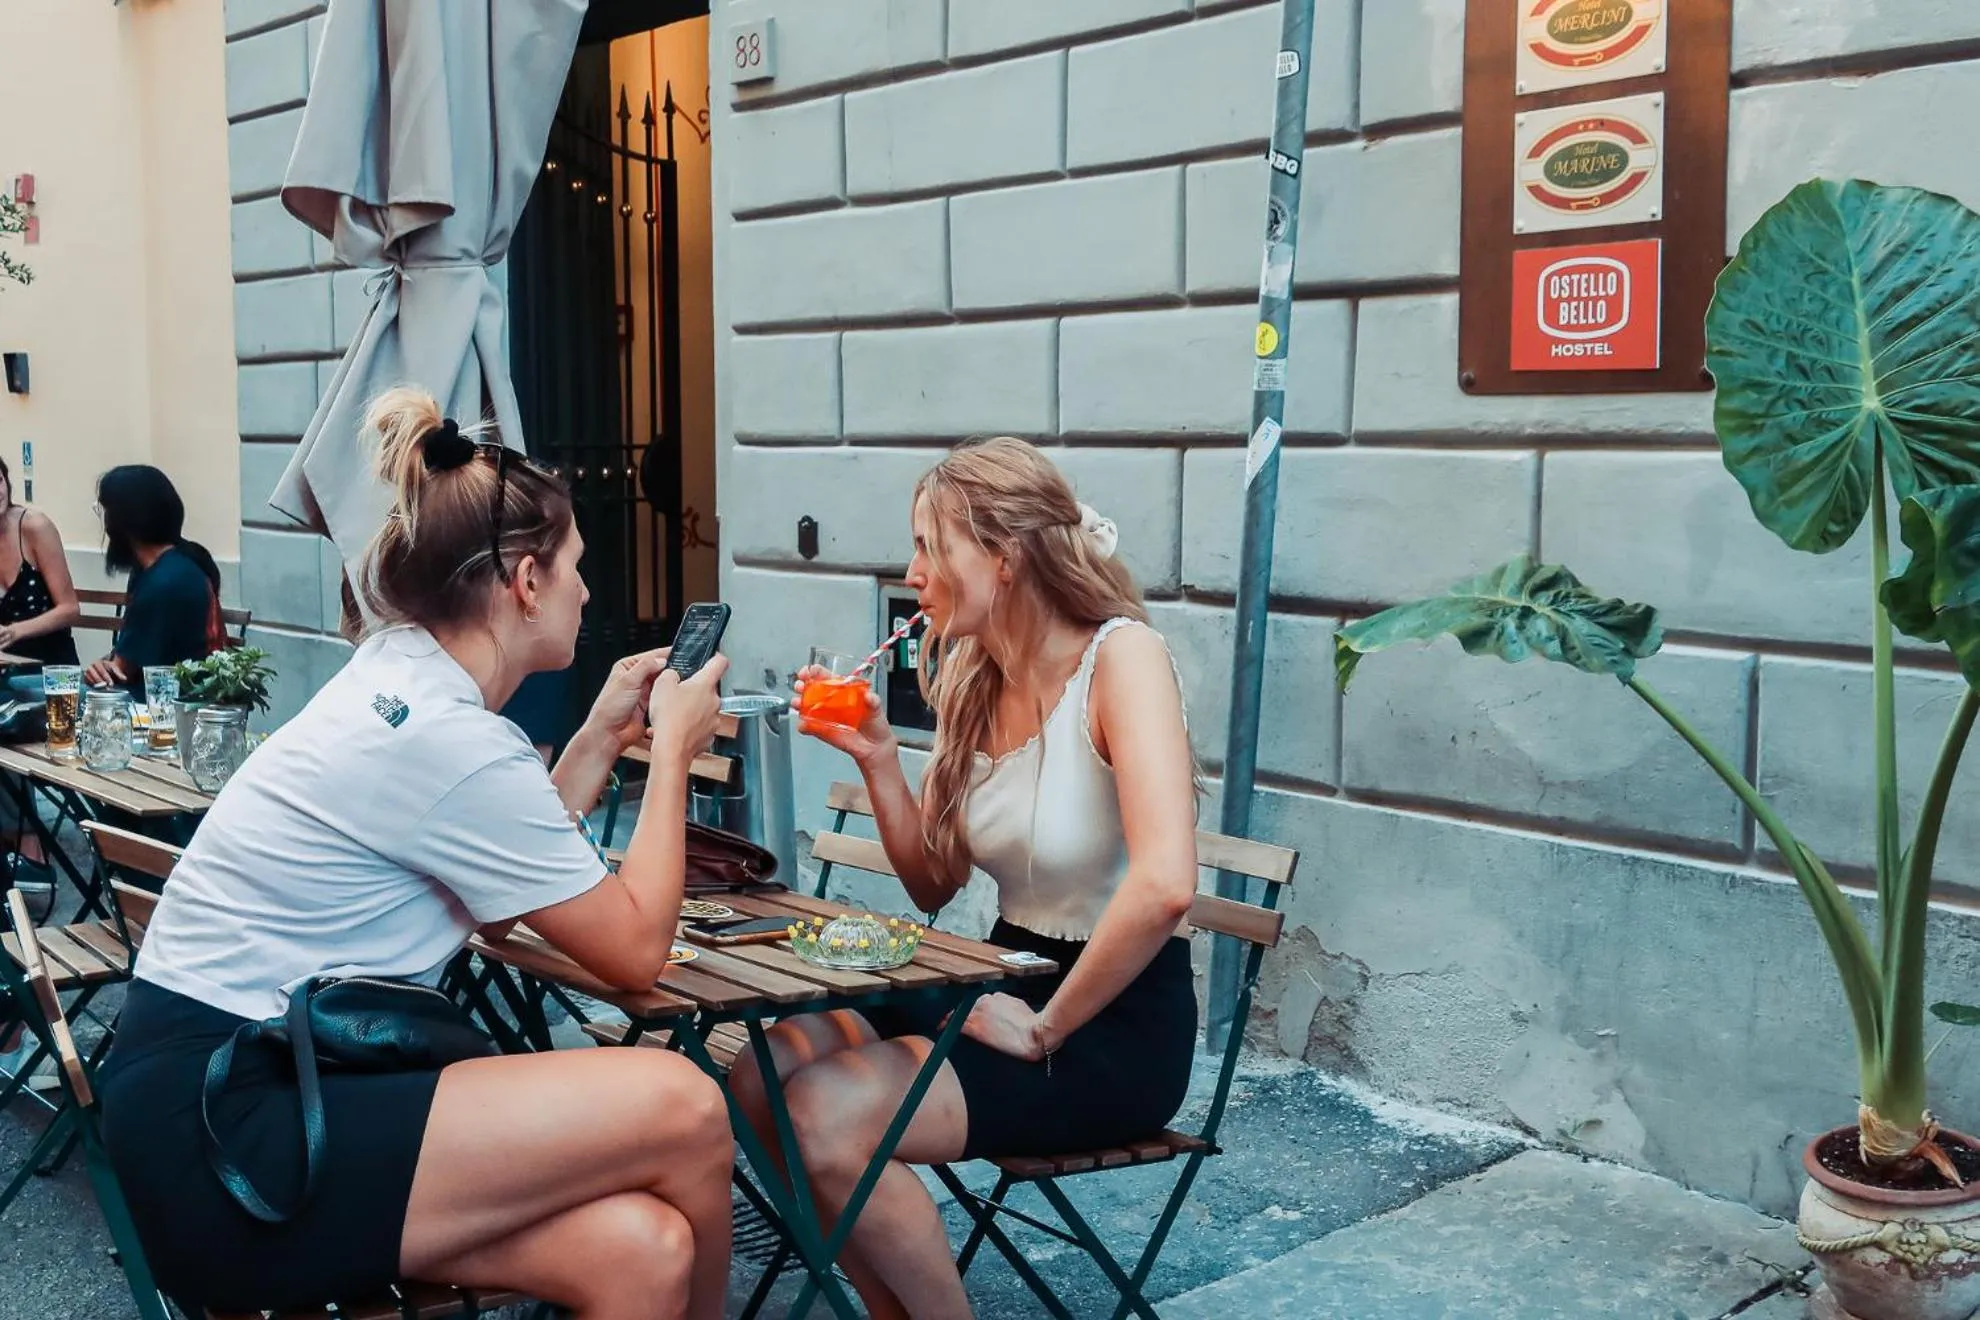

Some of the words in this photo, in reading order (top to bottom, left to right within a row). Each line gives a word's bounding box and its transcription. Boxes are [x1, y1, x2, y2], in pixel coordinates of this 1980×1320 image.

[735, 32, 760, 69] 88
[1553, 153, 1620, 177] MARINE
[1550, 271, 1617, 299] OSTELLO
[1558, 299, 1607, 326] BELLO
[1551, 342, 1614, 357] HOSTEL
